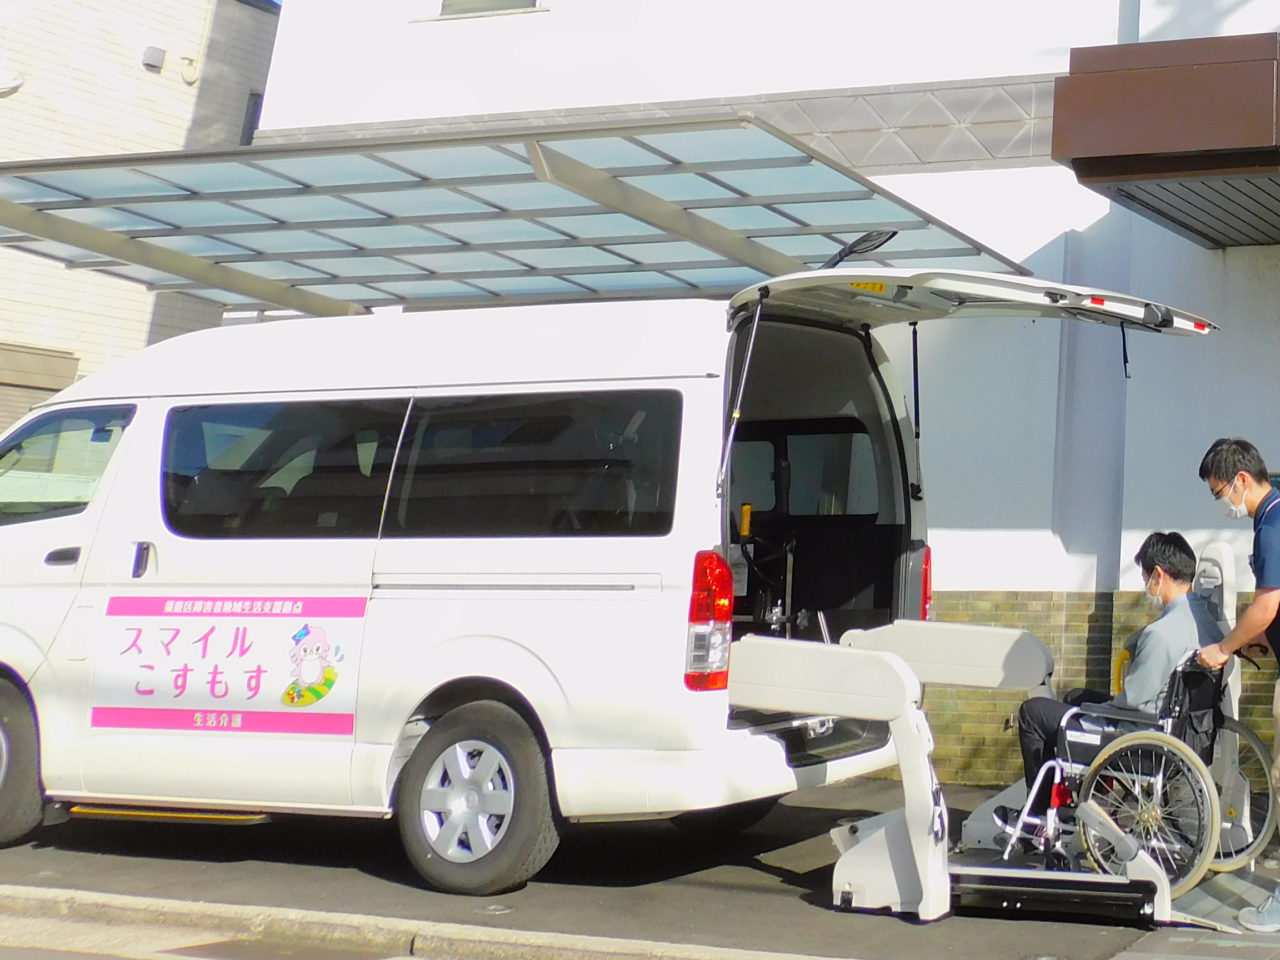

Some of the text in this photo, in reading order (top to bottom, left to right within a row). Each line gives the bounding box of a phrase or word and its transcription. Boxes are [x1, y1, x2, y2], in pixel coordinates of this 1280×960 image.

[120, 625, 254, 660] スマイル
[135, 663, 268, 700] こすもす
[192, 713, 243, 728] 生活介護
